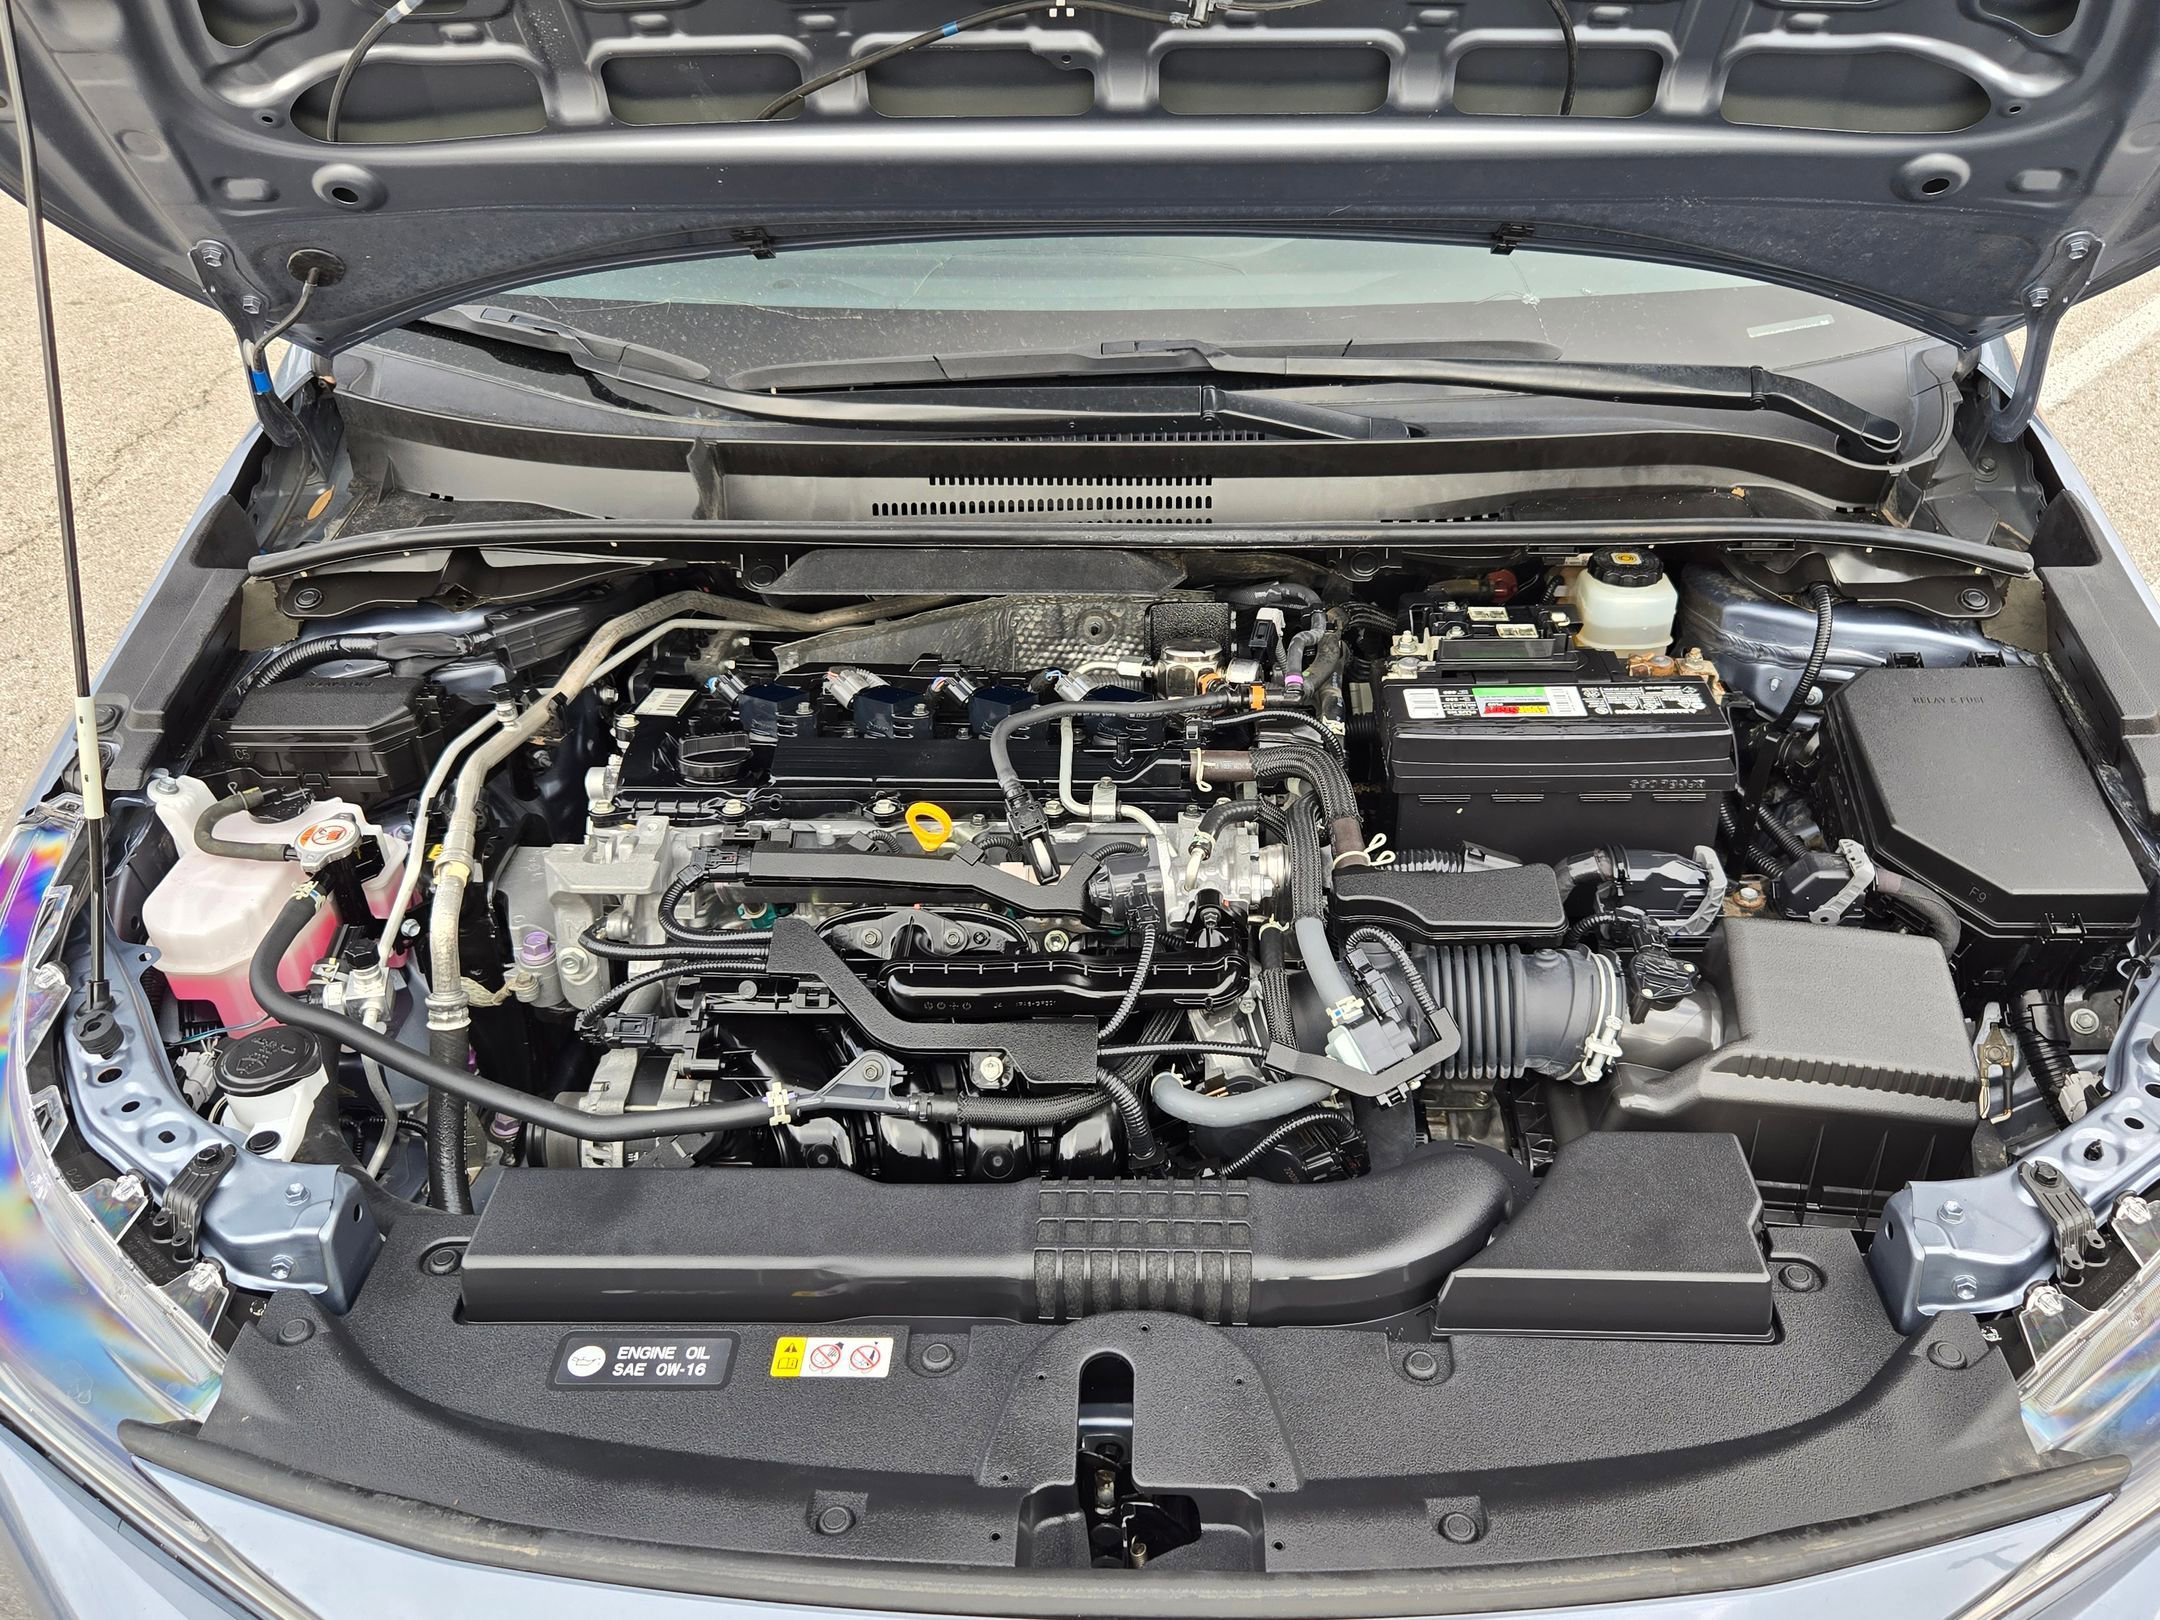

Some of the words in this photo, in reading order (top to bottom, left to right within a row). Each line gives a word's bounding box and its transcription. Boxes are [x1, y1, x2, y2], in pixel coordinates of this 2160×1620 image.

[1968, 886, 1987, 903] F9
[616, 1346, 677, 1360] ENGINE
[685, 1346, 711, 1360] OIL
[612, 1362, 647, 1377] SAE
[655, 1362, 707, 1377] 0W-16
